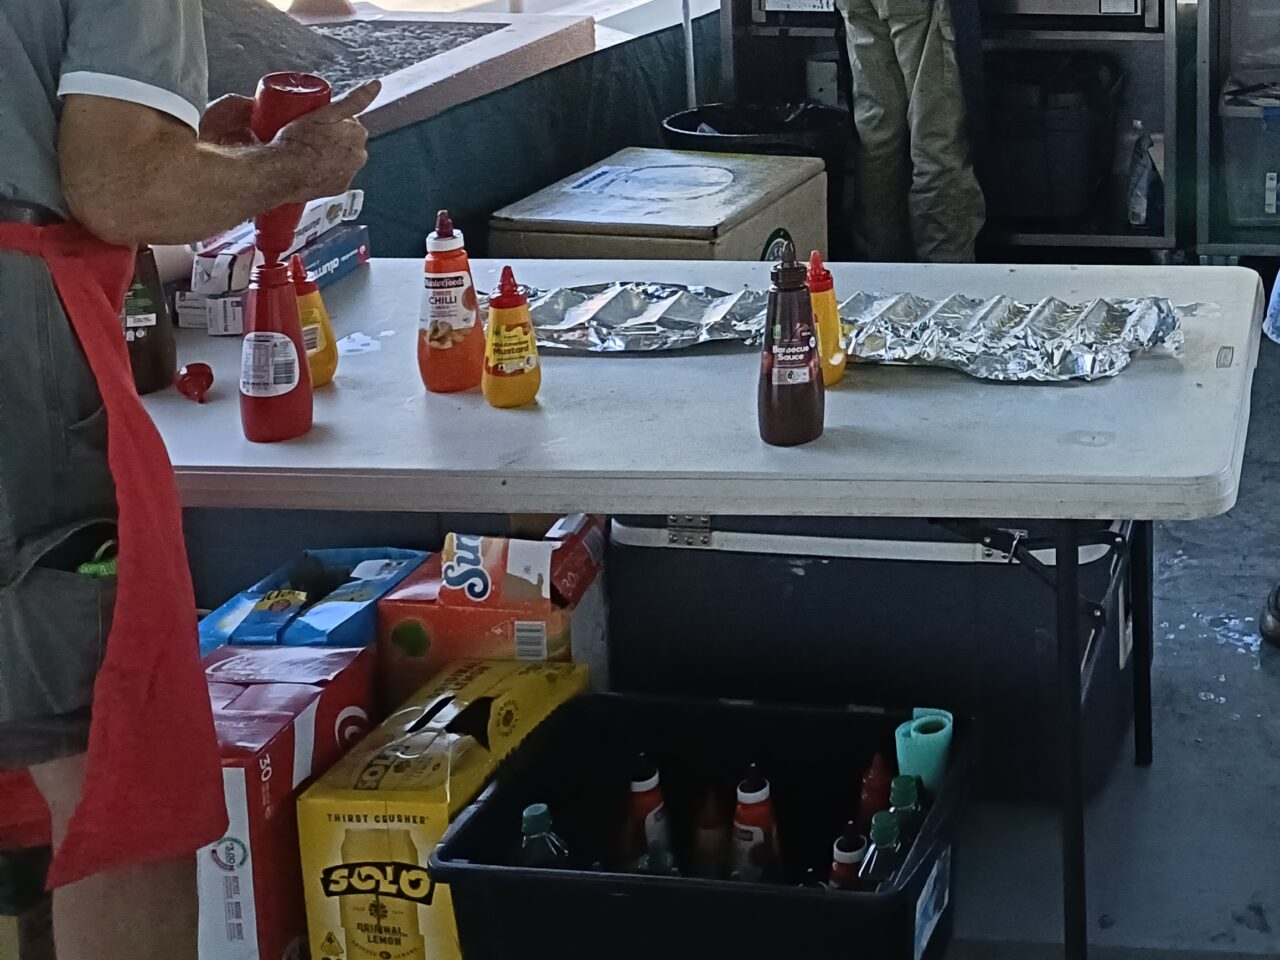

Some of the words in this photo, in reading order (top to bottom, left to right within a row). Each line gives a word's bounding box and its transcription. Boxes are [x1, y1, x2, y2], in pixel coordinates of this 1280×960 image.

[429, 296, 457, 305] CHILLI
[493, 345, 529, 355] Mustard
[259, 753, 273, 782] 30
[327, 813, 369, 823] THIRST
[328, 865, 431, 899] SOLO
[367, 935, 402, 946] LEMON
